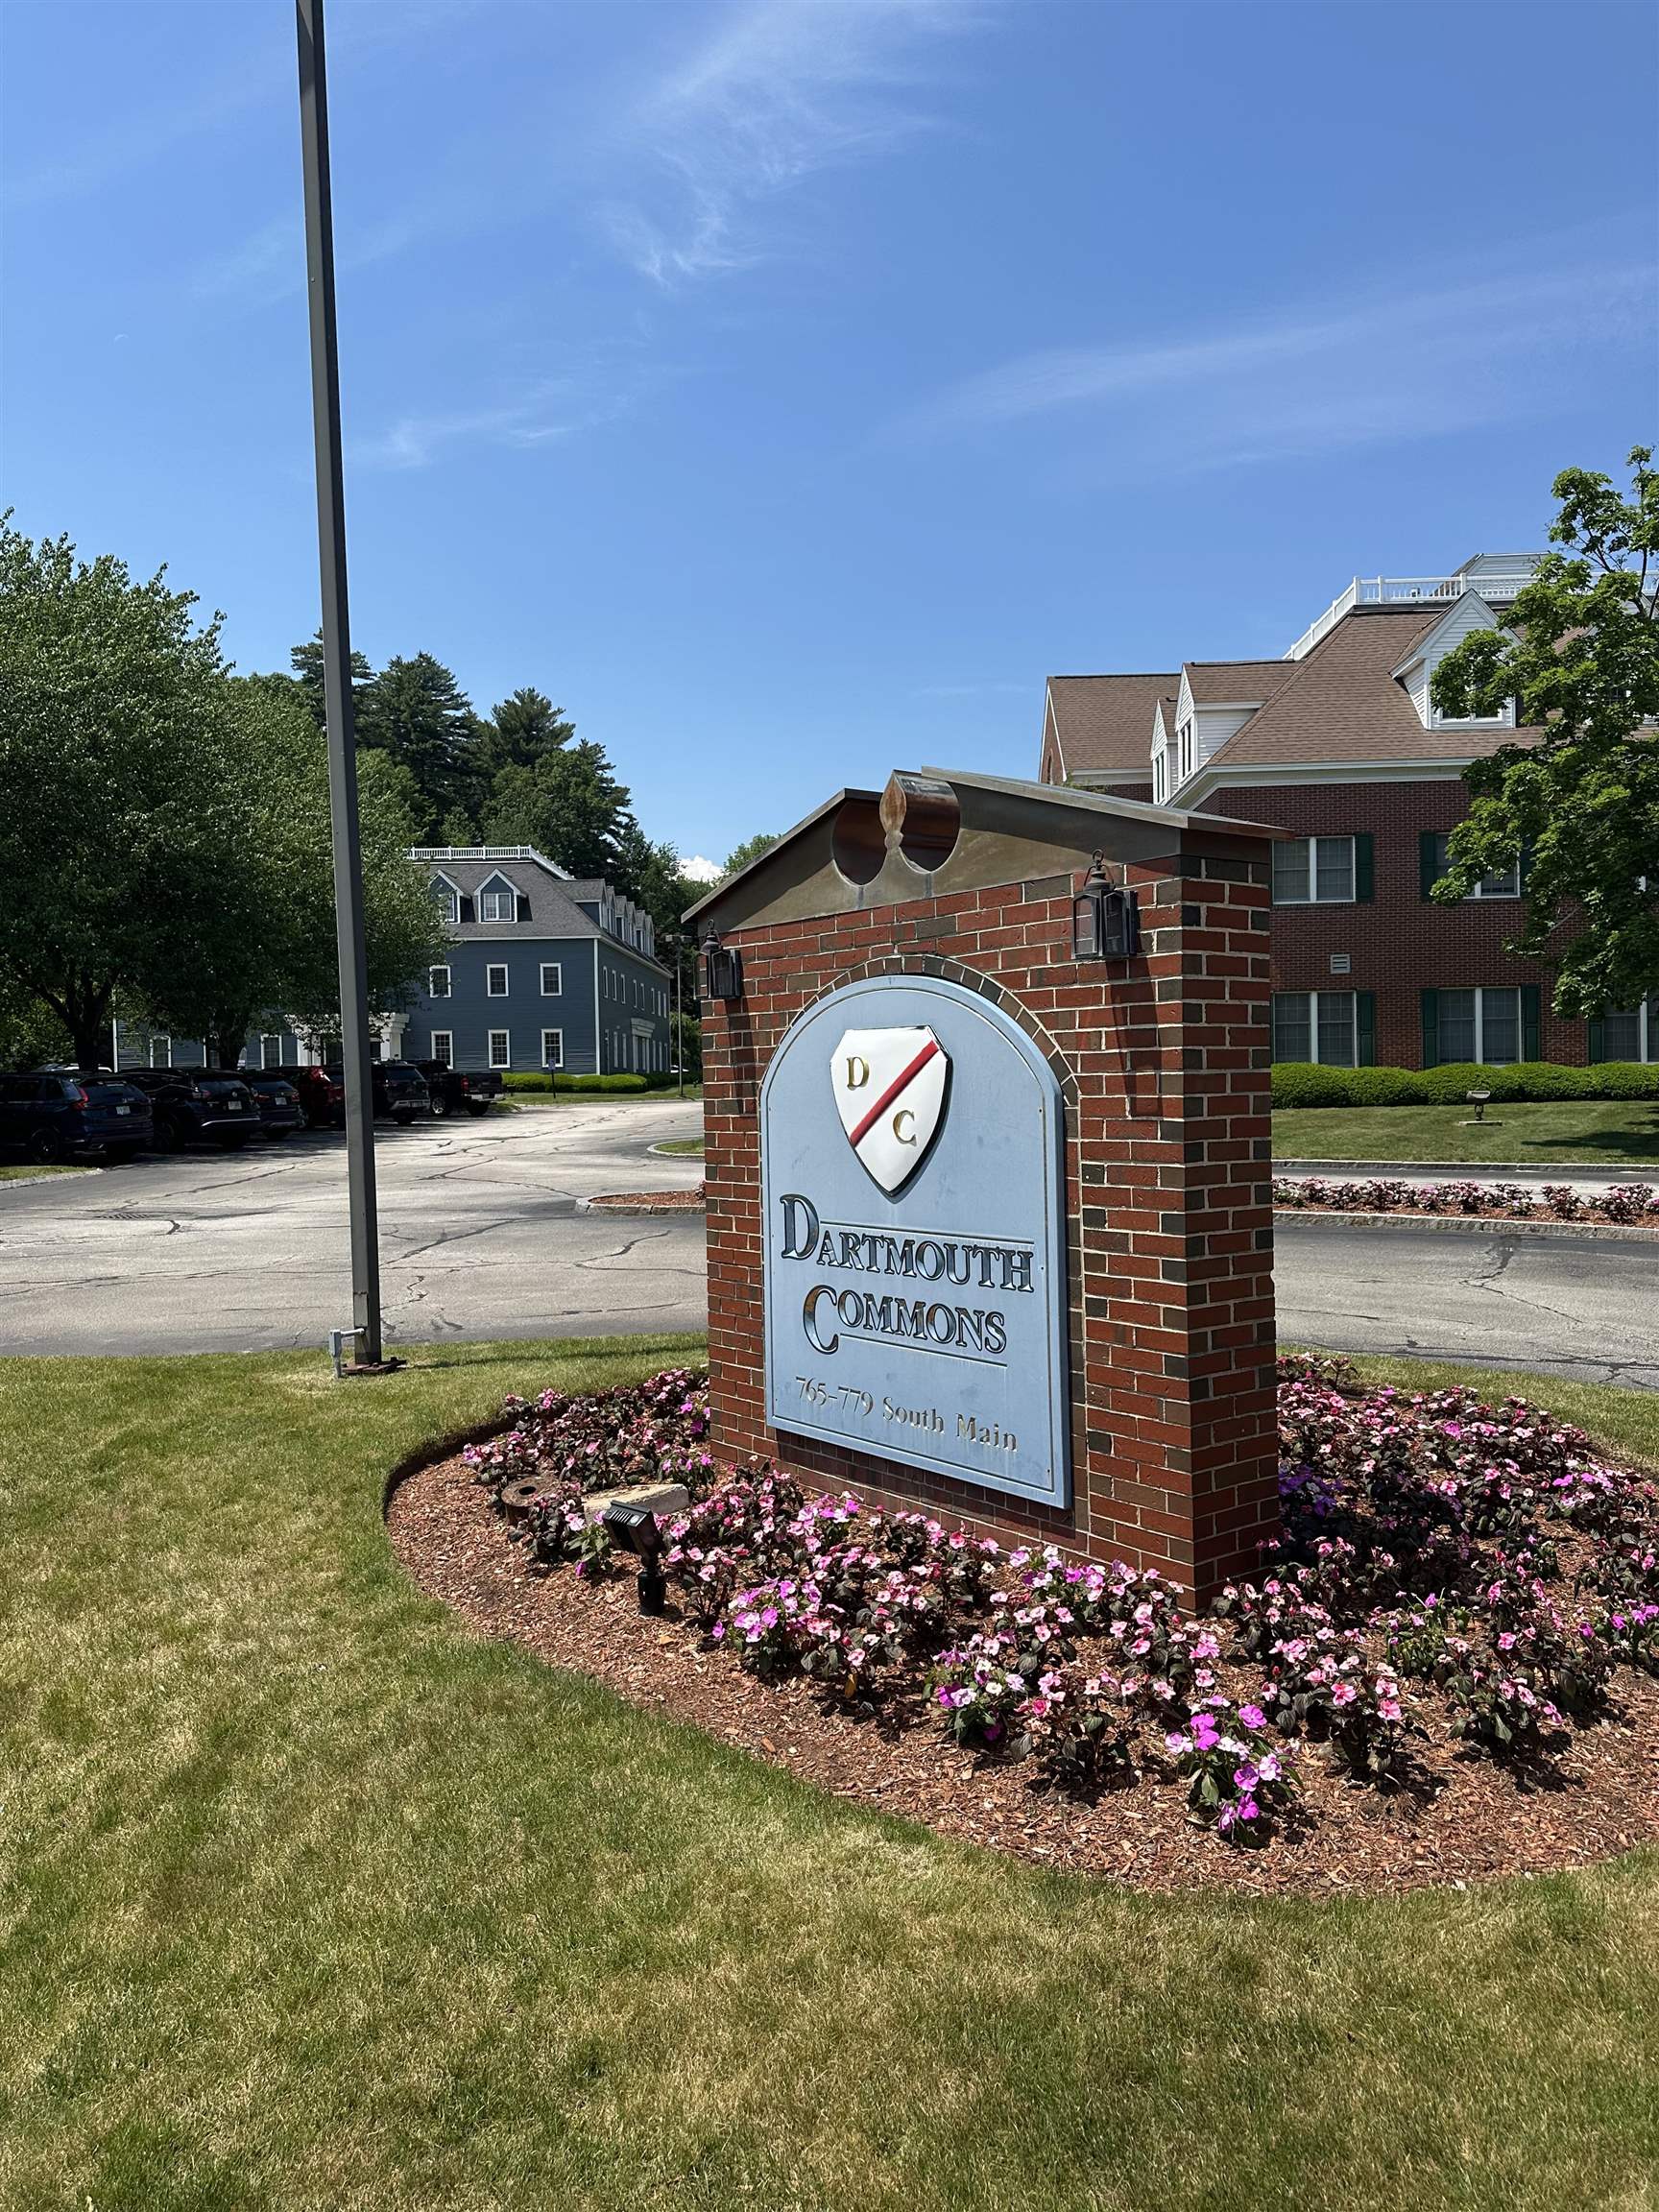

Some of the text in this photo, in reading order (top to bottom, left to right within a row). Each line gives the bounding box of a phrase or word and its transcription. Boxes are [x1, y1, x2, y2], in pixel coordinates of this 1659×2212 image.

[846, 1056, 870, 1089] D
[892, 1109, 917, 1145] C
[780, 1193, 1035, 1293] DARTMOUTH
[803, 1284, 1007, 1355] COMMONS
[795, 1375, 1018, 1453] 765-779 South Main
